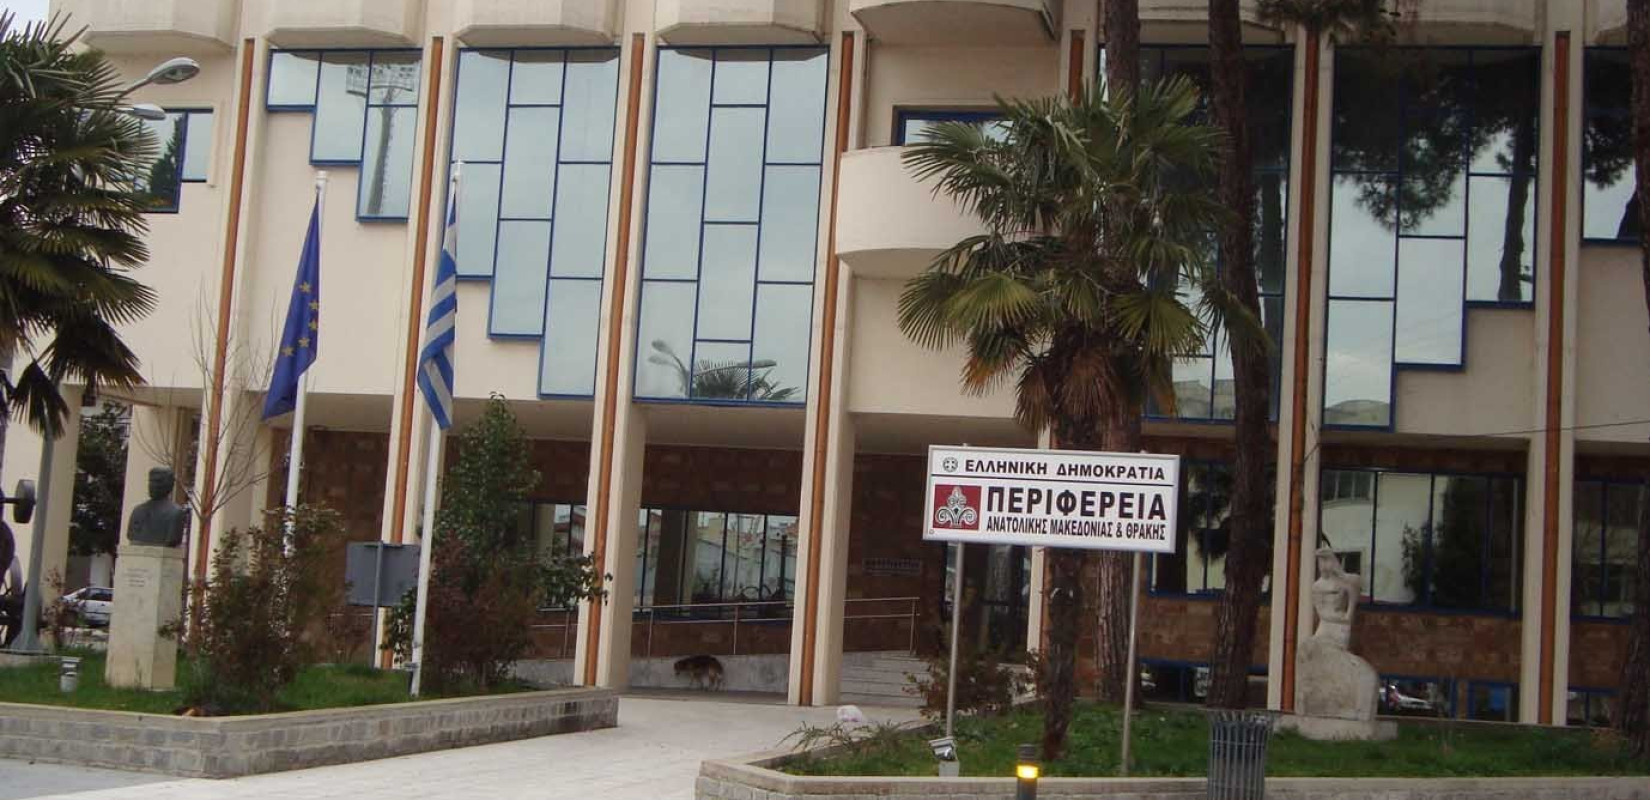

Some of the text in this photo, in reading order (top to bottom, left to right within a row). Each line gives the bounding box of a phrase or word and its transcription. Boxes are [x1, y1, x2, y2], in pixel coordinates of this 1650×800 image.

[965, 460, 1165, 480] ΕΛΛΗΝΙΚΗ ΔΗΜΟΚΡΑΤΙΑ
[987, 486, 1166, 520] ΠΕΡΙΦΕΡΕΙΑ
[986, 515, 1166, 541] ΑΝΑΤΟΛΙΚΗΣ ΜΑΚΕΔΟΝΙΑΣ & ΘΡΑΚΗΣ
